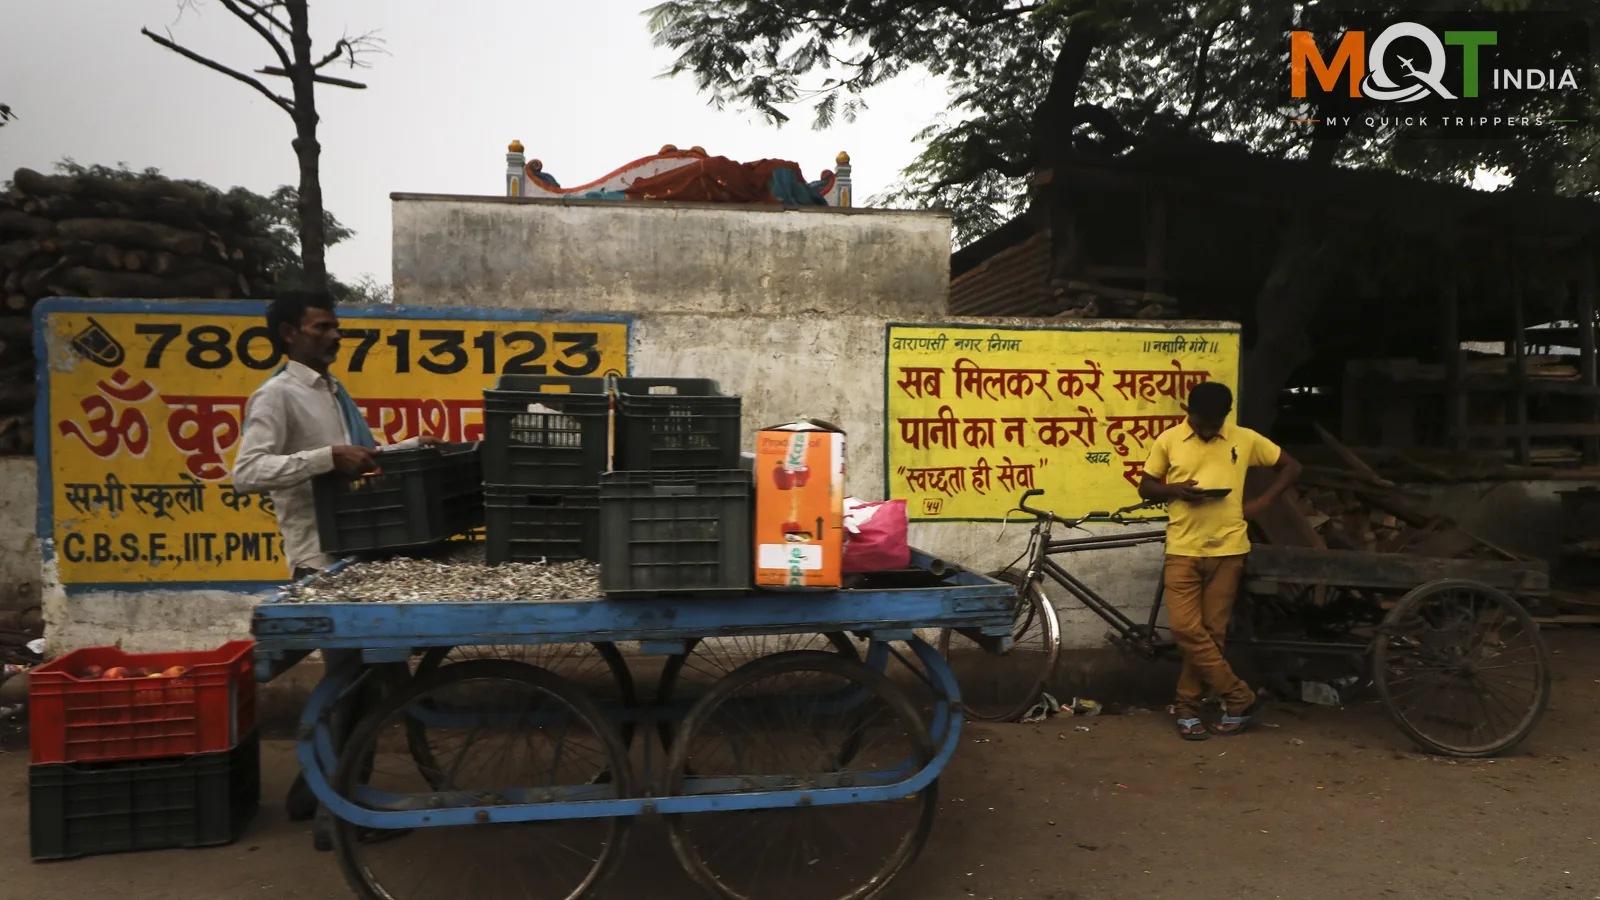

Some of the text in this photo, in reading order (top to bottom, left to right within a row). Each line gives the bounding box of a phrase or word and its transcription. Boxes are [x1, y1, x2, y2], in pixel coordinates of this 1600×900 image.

[134, 323, 601, 376] 780713123
[892, 333, 1022, 352] वाराणसी नगर निगम
[897, 367, 945, 399] सब
[952, 358, 1052, 401] मिलकर
[1057, 360, 1105, 401] करें
[897, 405, 960, 450] पानी
[963, 418, 997, 448] का
[1001, 418, 1028, 447] न
[64, 473, 126, 513] सभी
[969, 457, 992, 495] ही
